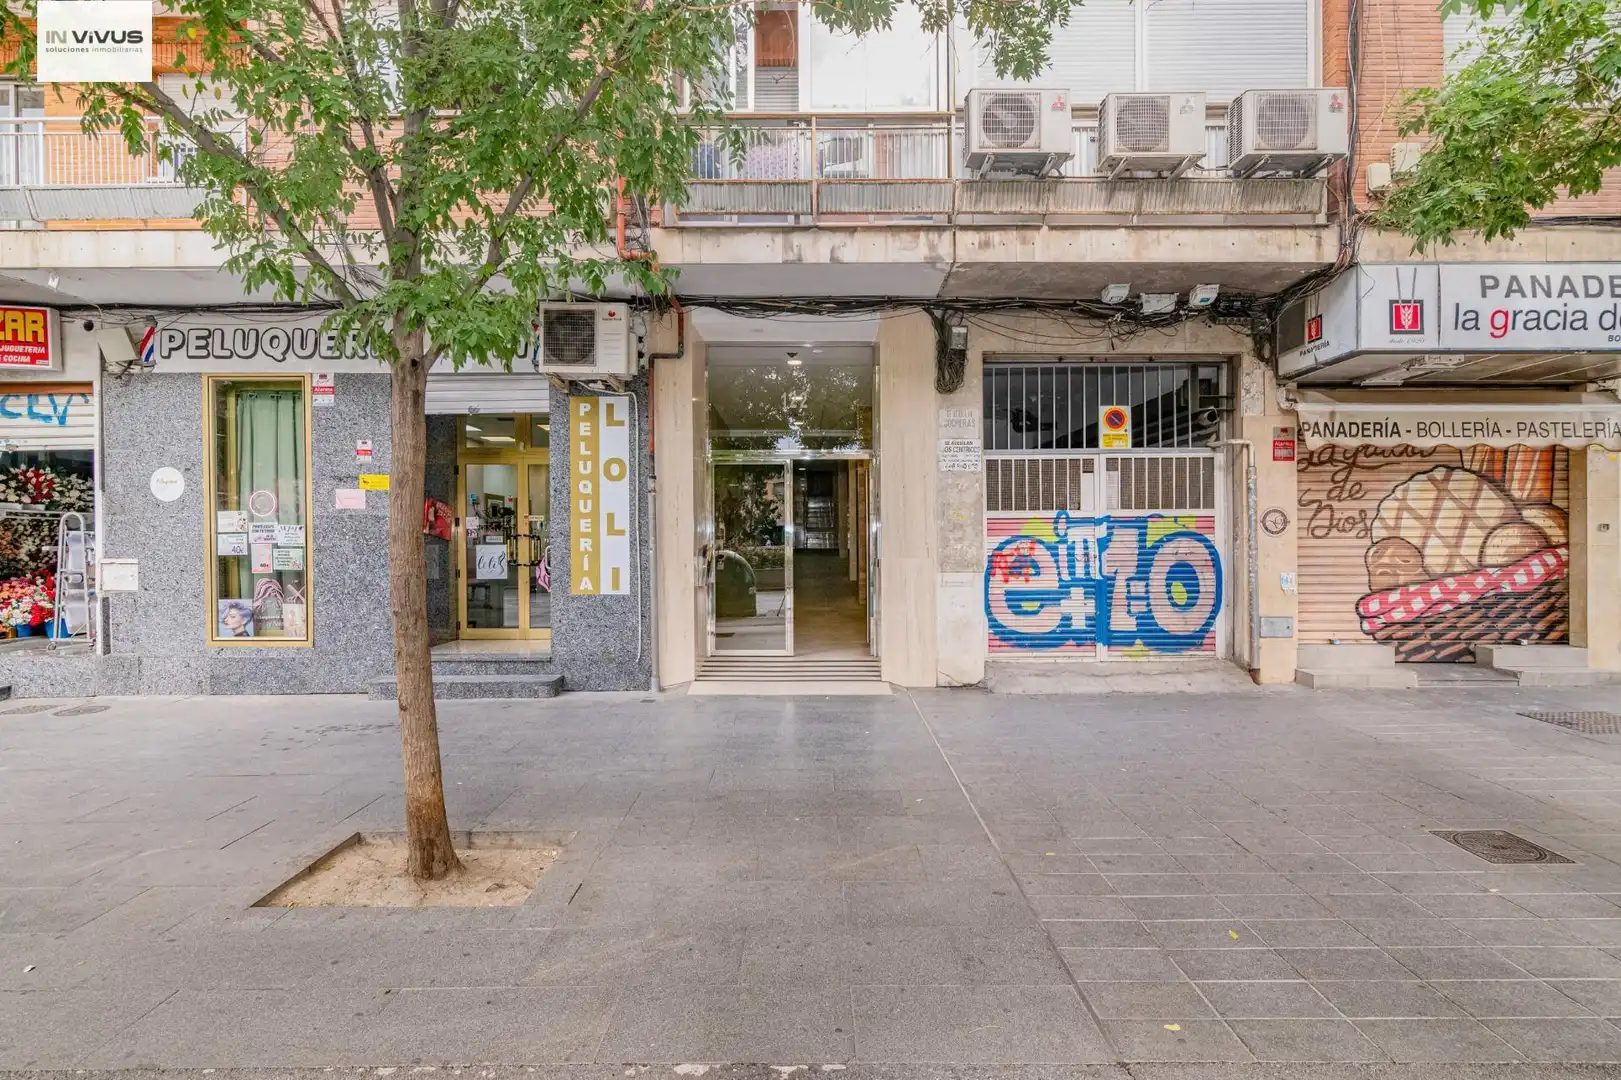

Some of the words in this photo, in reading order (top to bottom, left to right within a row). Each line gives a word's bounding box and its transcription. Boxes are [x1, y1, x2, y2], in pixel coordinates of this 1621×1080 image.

[1479, 275, 1621, 299] PANADE
[1453, 303, 1481, 331] la
[1489, 303, 1590, 339] gracia
[1598, 303, 1621, 331] d
[3, 354, 31, 363] COCINA
[159, 328, 386, 362] PELUQUER
[1301, 418, 1401, 438] PANADERÍA
[1417, 418, 1501, 438] BOLLERÍA
[1516, 418, 1621, 438] PASTELERÍA
[578, 403, 593, 591] PELUQUERÍA
[603, 403, 627, 592] LOLI
